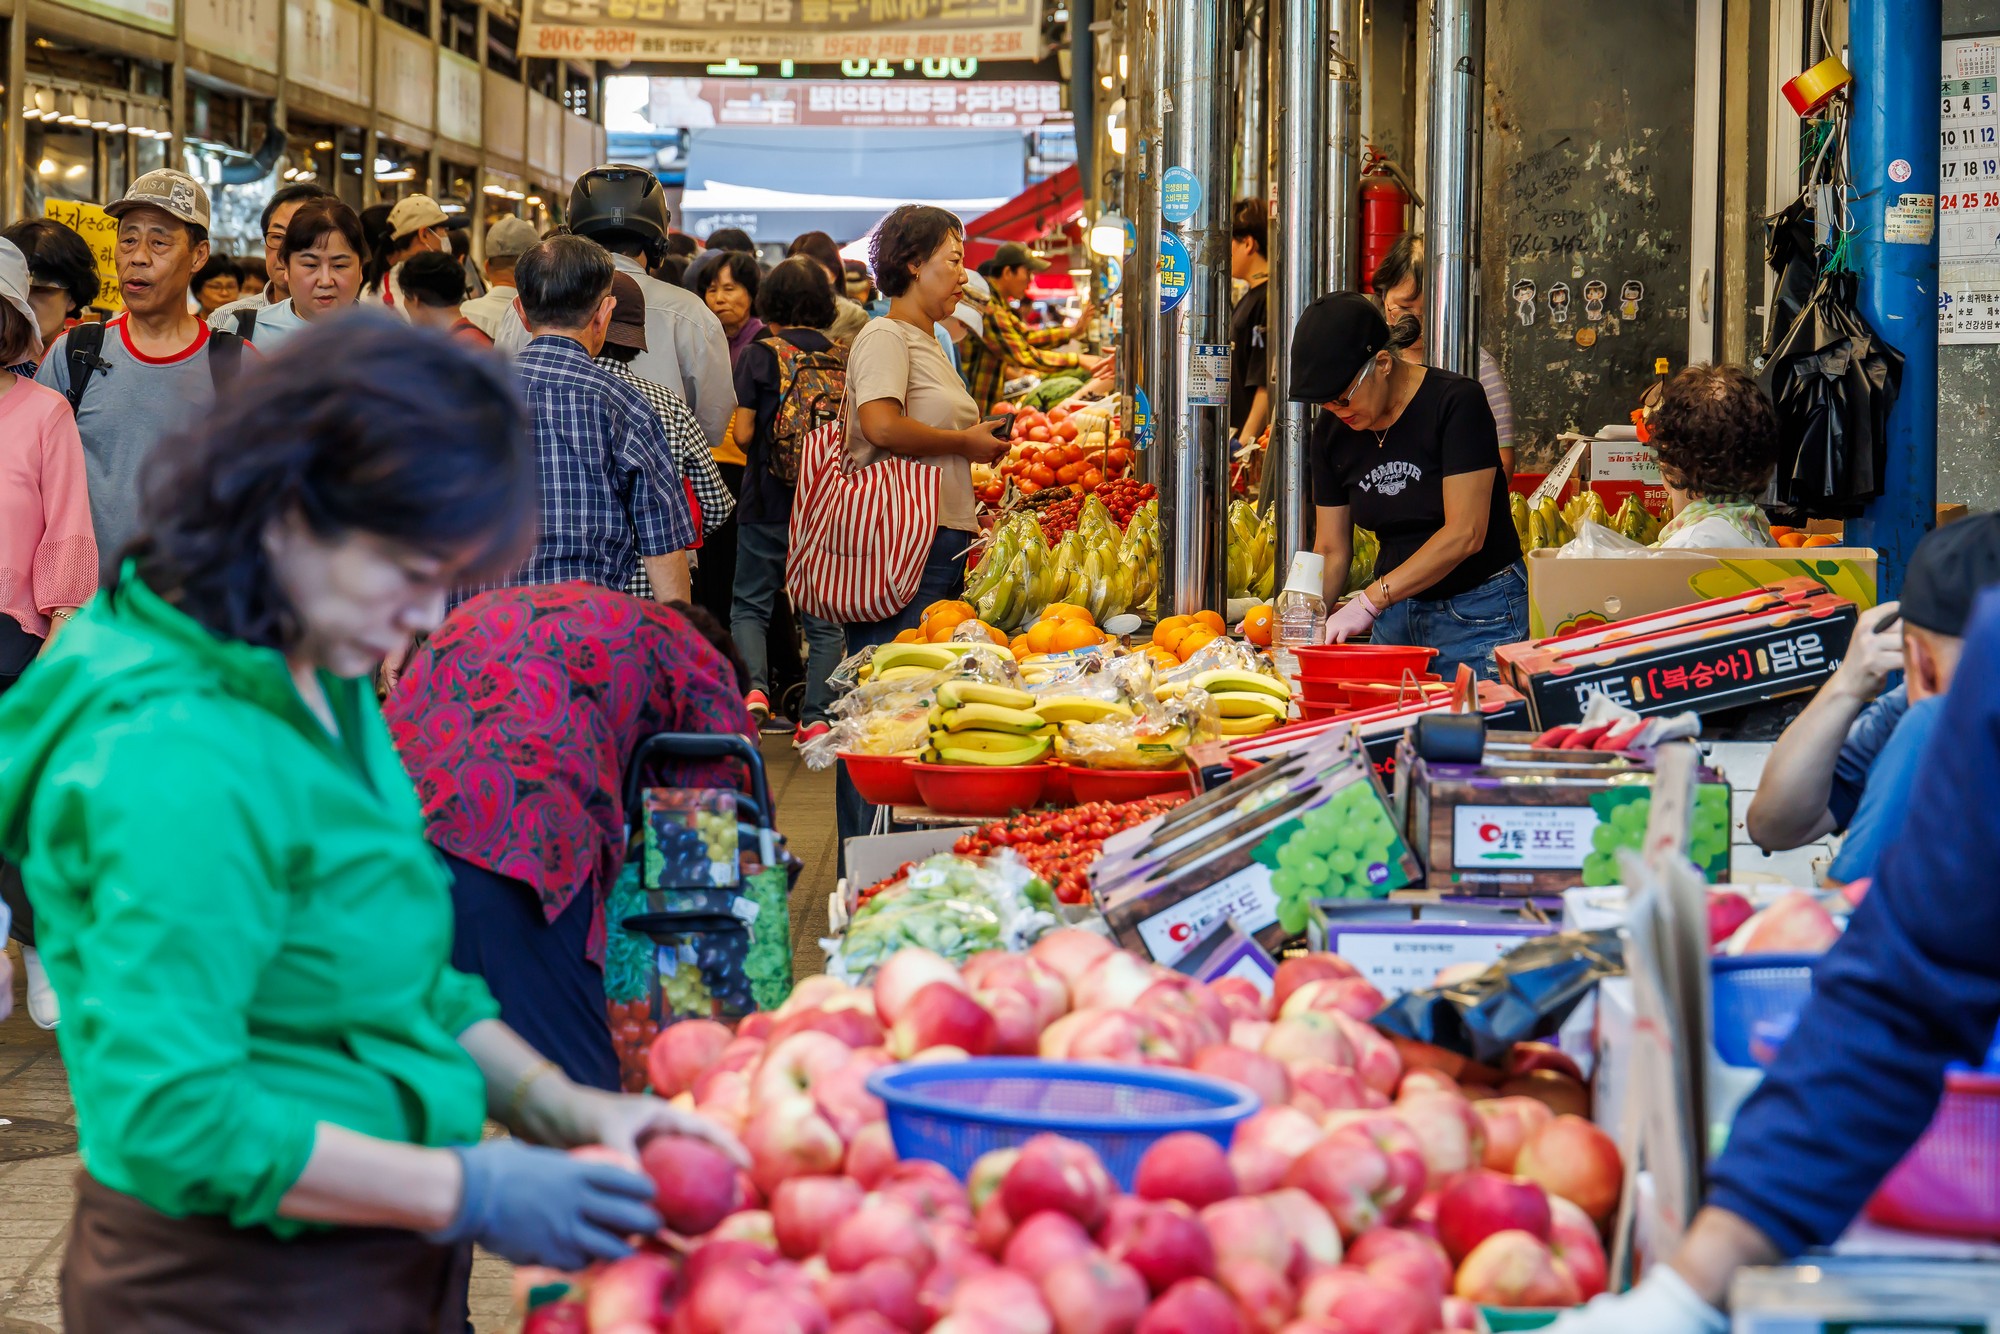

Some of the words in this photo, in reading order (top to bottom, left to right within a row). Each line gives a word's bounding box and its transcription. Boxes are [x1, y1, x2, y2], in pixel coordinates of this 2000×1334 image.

[1942, 83, 1951, 91] 木
[1961, 81, 1970, 90] 金
[1982, 79, 1990, 88] 土
[1943, 99, 1951, 113] 3
[1963, 97, 1970, 111] 4
[1982, 95, 1990, 110] 5
[1941, 131, 1955, 146] 10
[1963, 129, 1975, 144] 11
[1981, 127, 1994, 142] 12
[1941, 163, 1956, 177] 17
[1964, 161, 1977, 176] 18
[1983, 160, 1996, 174] 19
[143, 180, 165, 190] USA
[1165, 194, 1189, 202] 소비쿠폰
[1941, 195, 1957, 209] 24
[1962, 193, 1978, 208] 25
[1983, 192, 1999, 207] 26
[1966, 227, 1974, 239] 2
[1967, 294, 1992, 303] 희귀약초
[1965, 320, 1993, 330] 건강상담
[1359, 461, 1422, 493] L'AMOUR
[1644, 490, 1669, 499] 토마토
[1768, 633, 1825, 674] 담은
[1532, 829, 1576, 849] 포도
